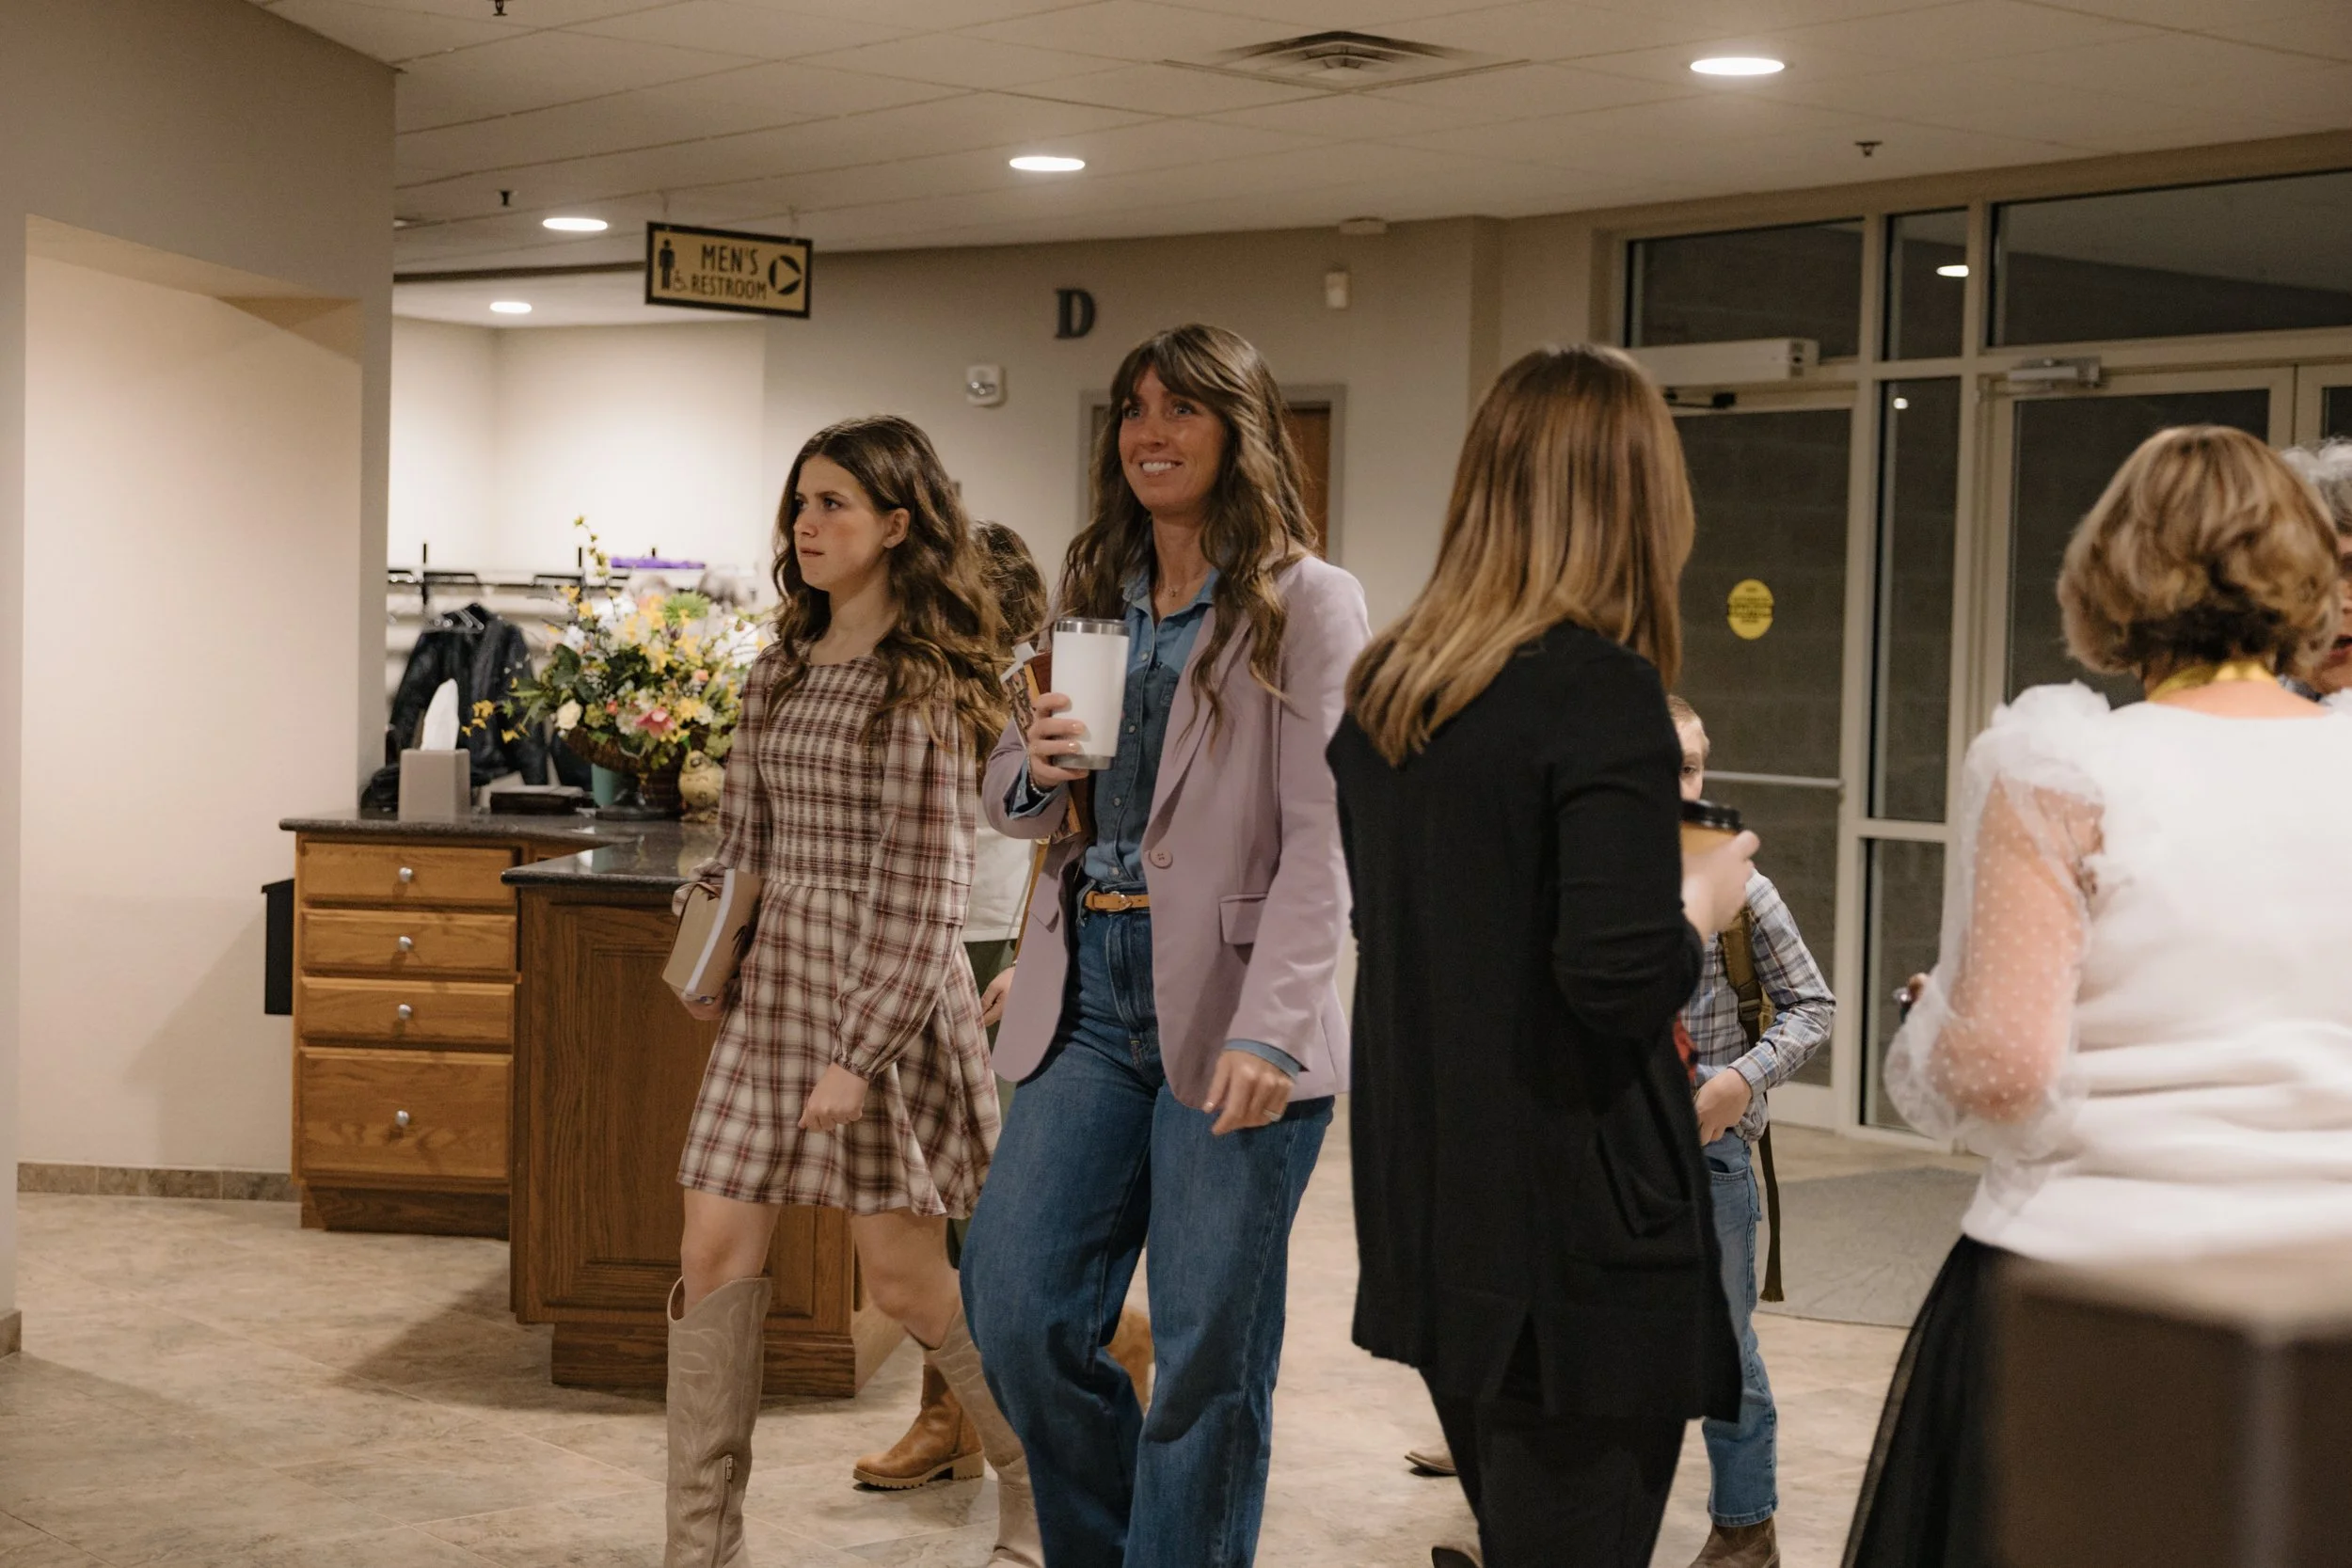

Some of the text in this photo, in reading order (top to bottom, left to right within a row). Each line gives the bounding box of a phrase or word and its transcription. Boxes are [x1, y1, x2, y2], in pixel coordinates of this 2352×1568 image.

[701, 244, 759, 276] MEN'S
[691, 272, 768, 300] RESTROOM
[1055, 288, 1096, 340] D
